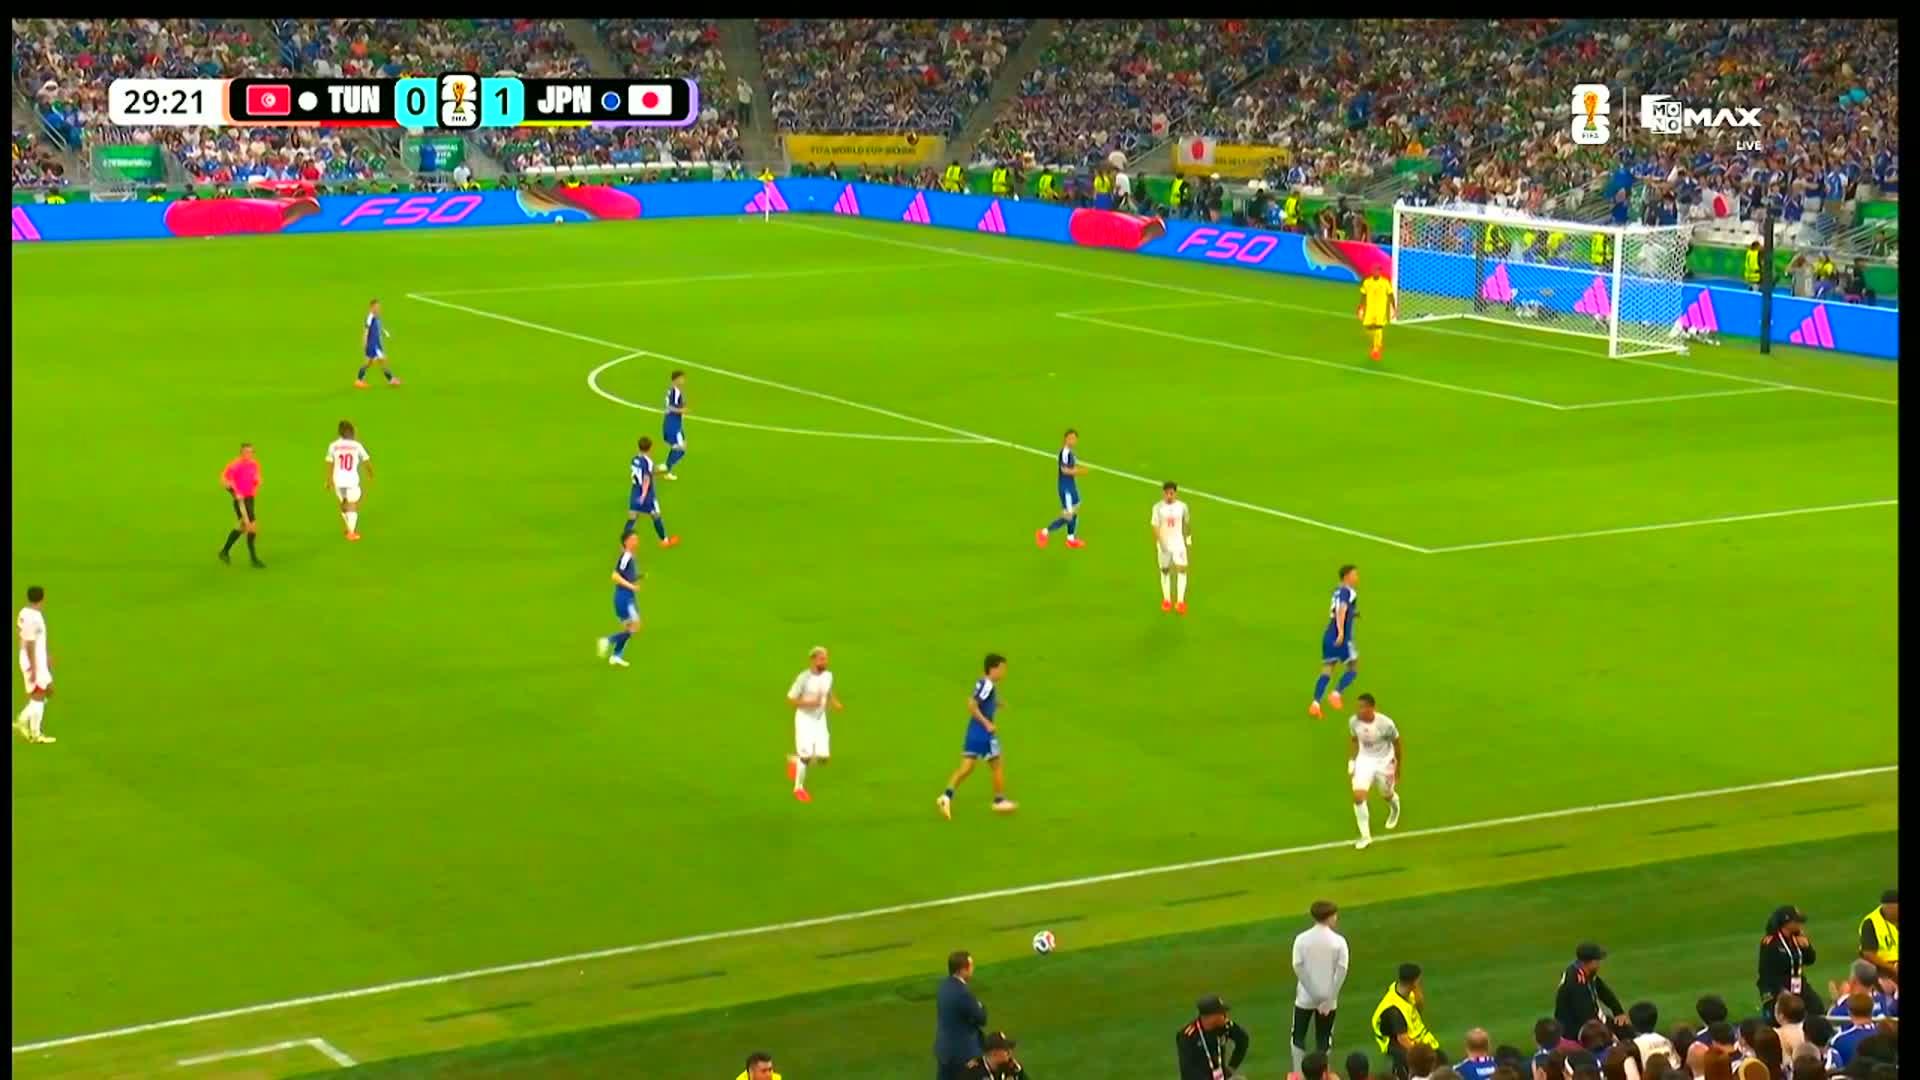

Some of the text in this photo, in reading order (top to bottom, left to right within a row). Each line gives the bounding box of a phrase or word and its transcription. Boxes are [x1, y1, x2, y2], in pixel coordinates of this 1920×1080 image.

[341, 195, 482, 226] F50
[1177, 228, 1278, 263] F50
[339, 453, 353, 471] 10
